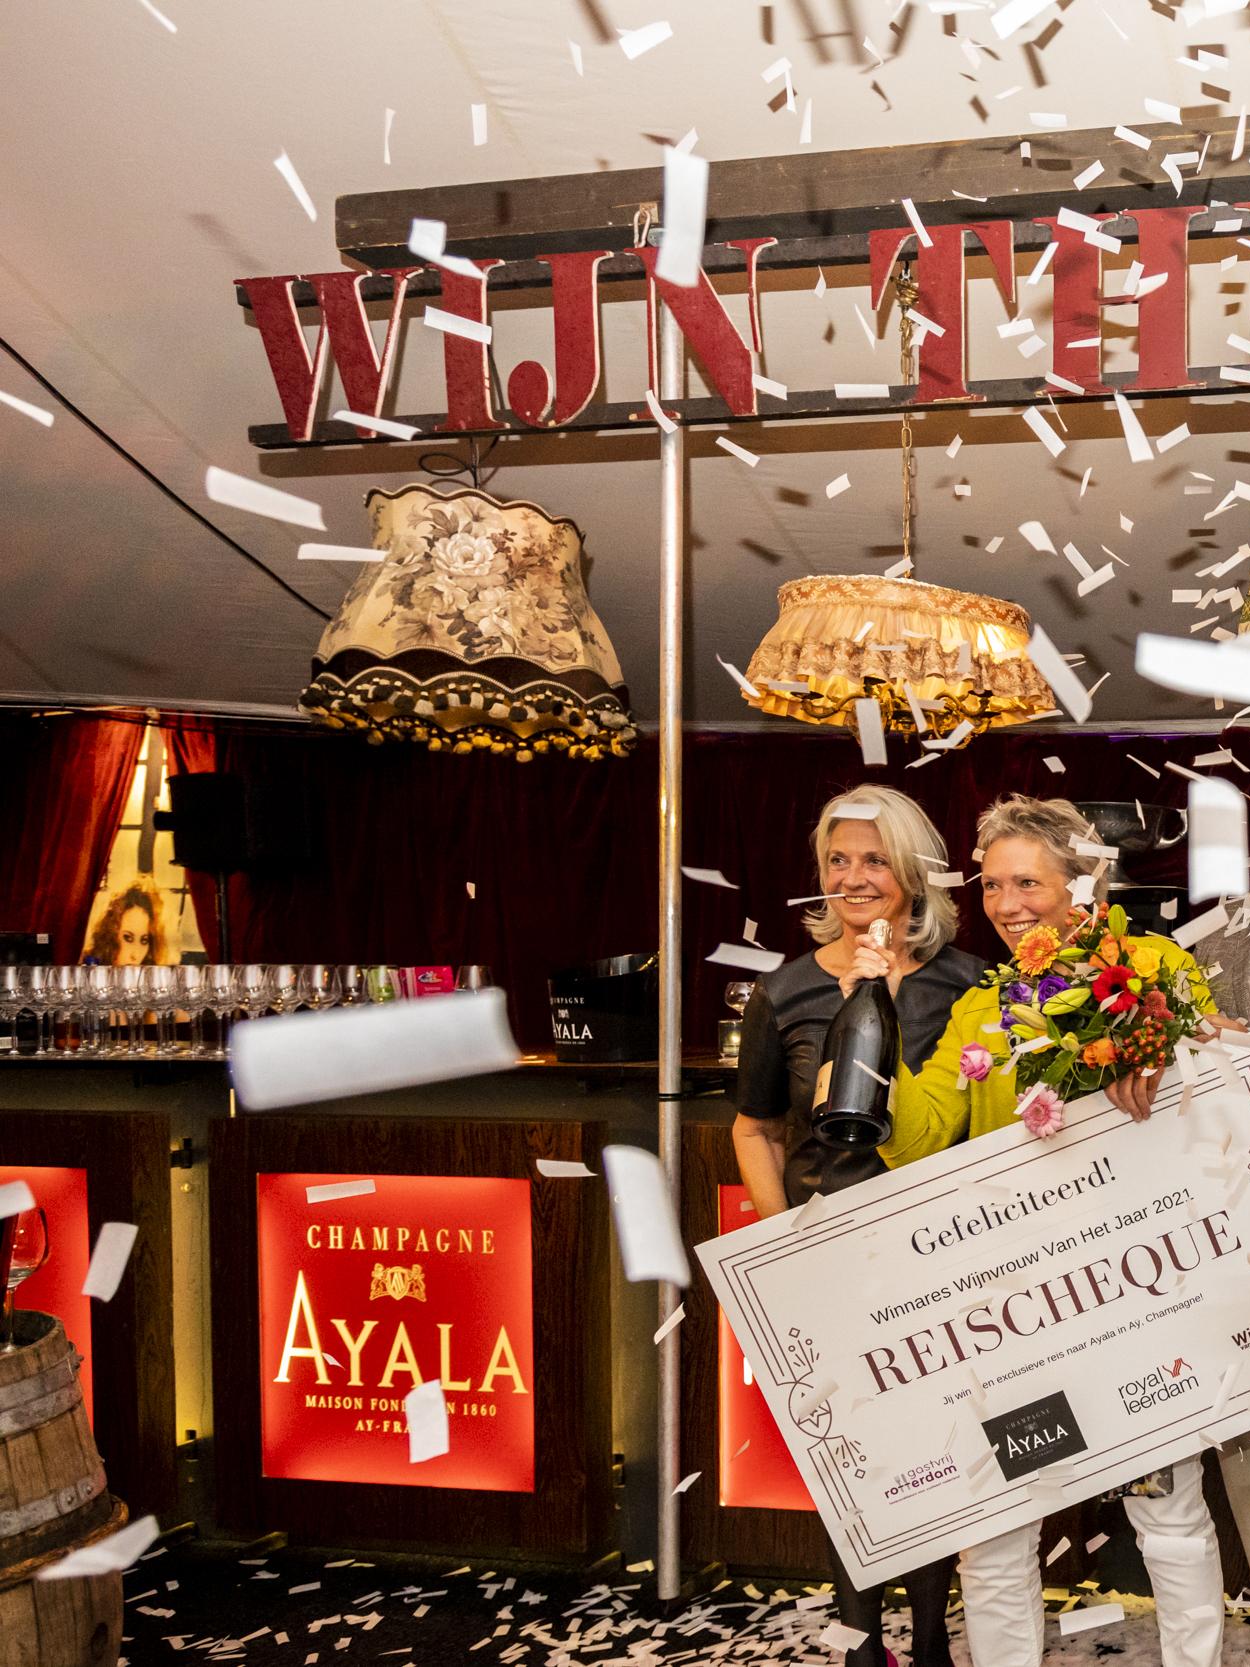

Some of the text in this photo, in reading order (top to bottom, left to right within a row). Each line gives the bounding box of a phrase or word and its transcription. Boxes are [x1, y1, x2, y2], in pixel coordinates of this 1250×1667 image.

[233, 237, 777, 441] WIJN
[911, 1157, 1117, 1256] Gefeliciteerd!
[306, 1224, 495, 1255] CHAMPAGNE
[870, 1188, 1195, 1325] Winnares Wijnvrouw Van Het Jaar 2021
[859, 1209, 1242, 1395] REISCHEQUE
[273, 1269, 529, 1394] AYALA
[954, 1387, 972, 1401] win
[982, 1378, 995, 1389] en
[997, 1358, 1045, 1384] exclusieve
[1047, 1351, 1065, 1364] reis
[1066, 1342, 1088, 1356] naar
[1089, 1330, 1116, 1348] Ayala
[1118, 1325, 1127, 1335] in
[1145, 1292, 1204, 1323] Champagne!
[1118, 1367, 1164, 1399] royal
[1124, 1376, 1199, 1415] leerdam
[305, 1395, 363, 1410] MAISON
[371, 1398, 407, 1412] FOND
[463, 1404, 497, 1417] 1860
[355, 1420, 412, 1434] AY-FRA
[1006, 1423, 1069, 1459] AYALA
[884, 1465, 957, 1499] rotterdam
[907, 1452, 954, 1480] gastvrij
